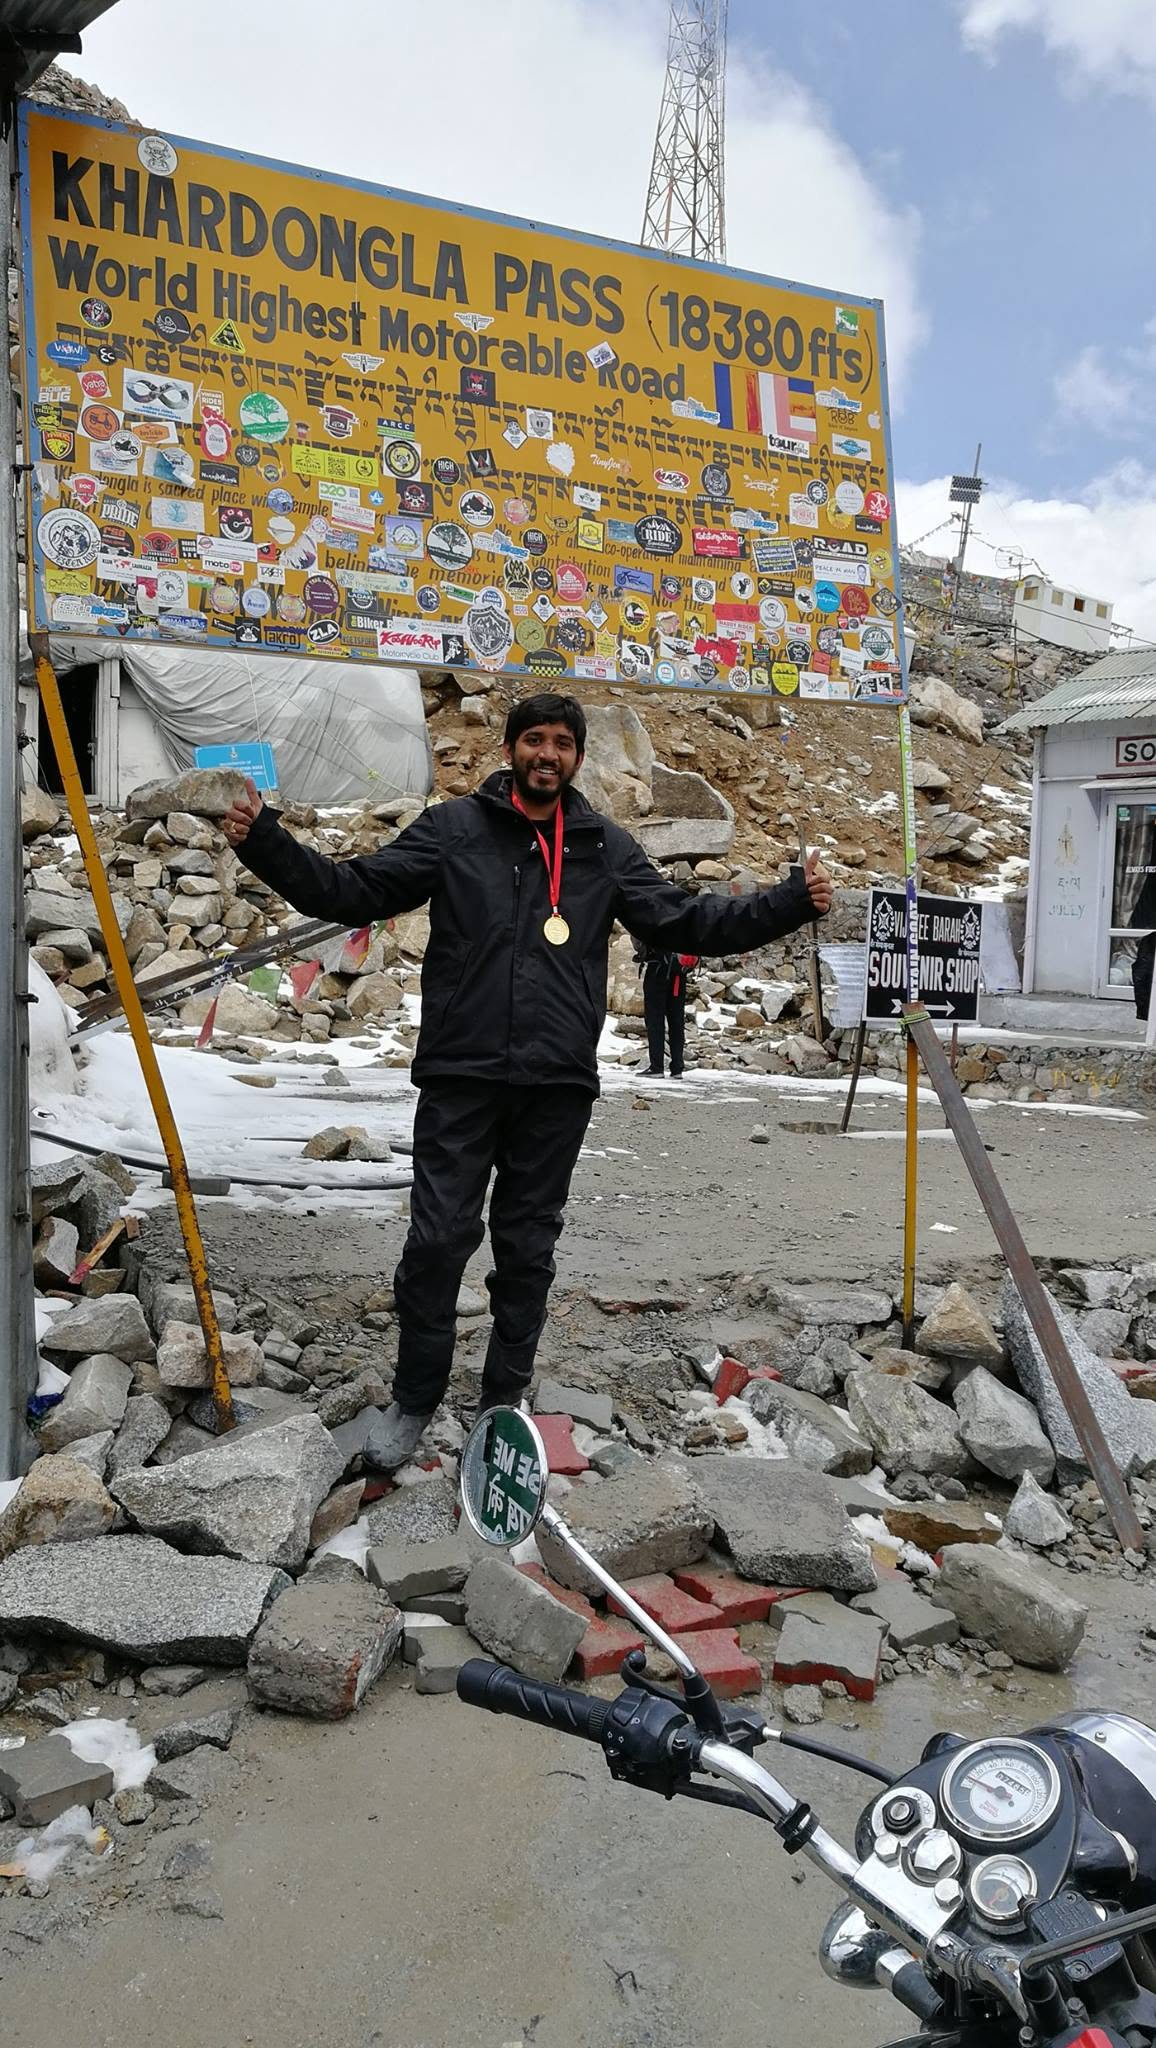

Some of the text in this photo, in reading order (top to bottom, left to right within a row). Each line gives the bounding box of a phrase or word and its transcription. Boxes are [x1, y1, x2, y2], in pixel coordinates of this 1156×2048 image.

[52, 149, 469, 304] KHARDONGLA
[494, 252, 625, 334] PASS
[48, 235, 199, 314] World
[213, 268, 367, 347] Highest
[379, 304, 587, 384] Motorable
[598, 347, 685, 401] Road
[39, 392, 71, 403] BUG
[202, 397, 222, 406] RIDES
[382, 420, 411, 430] ARCC
[768, 434, 798, 451] tour
[438, 460, 454, 472] HIGH
[211, 486, 246, 505] place
[527, 532, 543, 542] HIGH
[645, 528, 673, 543] RIDE
[204, 558, 230, 569] moto
[348, 592, 377, 601] LADAKH
[357, 616, 383, 630] Biker
[799, 610, 830, 623] your
[310, 623, 337, 641] ZLA
[381, 649, 440, 660] Motorcycle Club
[945, 958, 979, 994] SHOP
